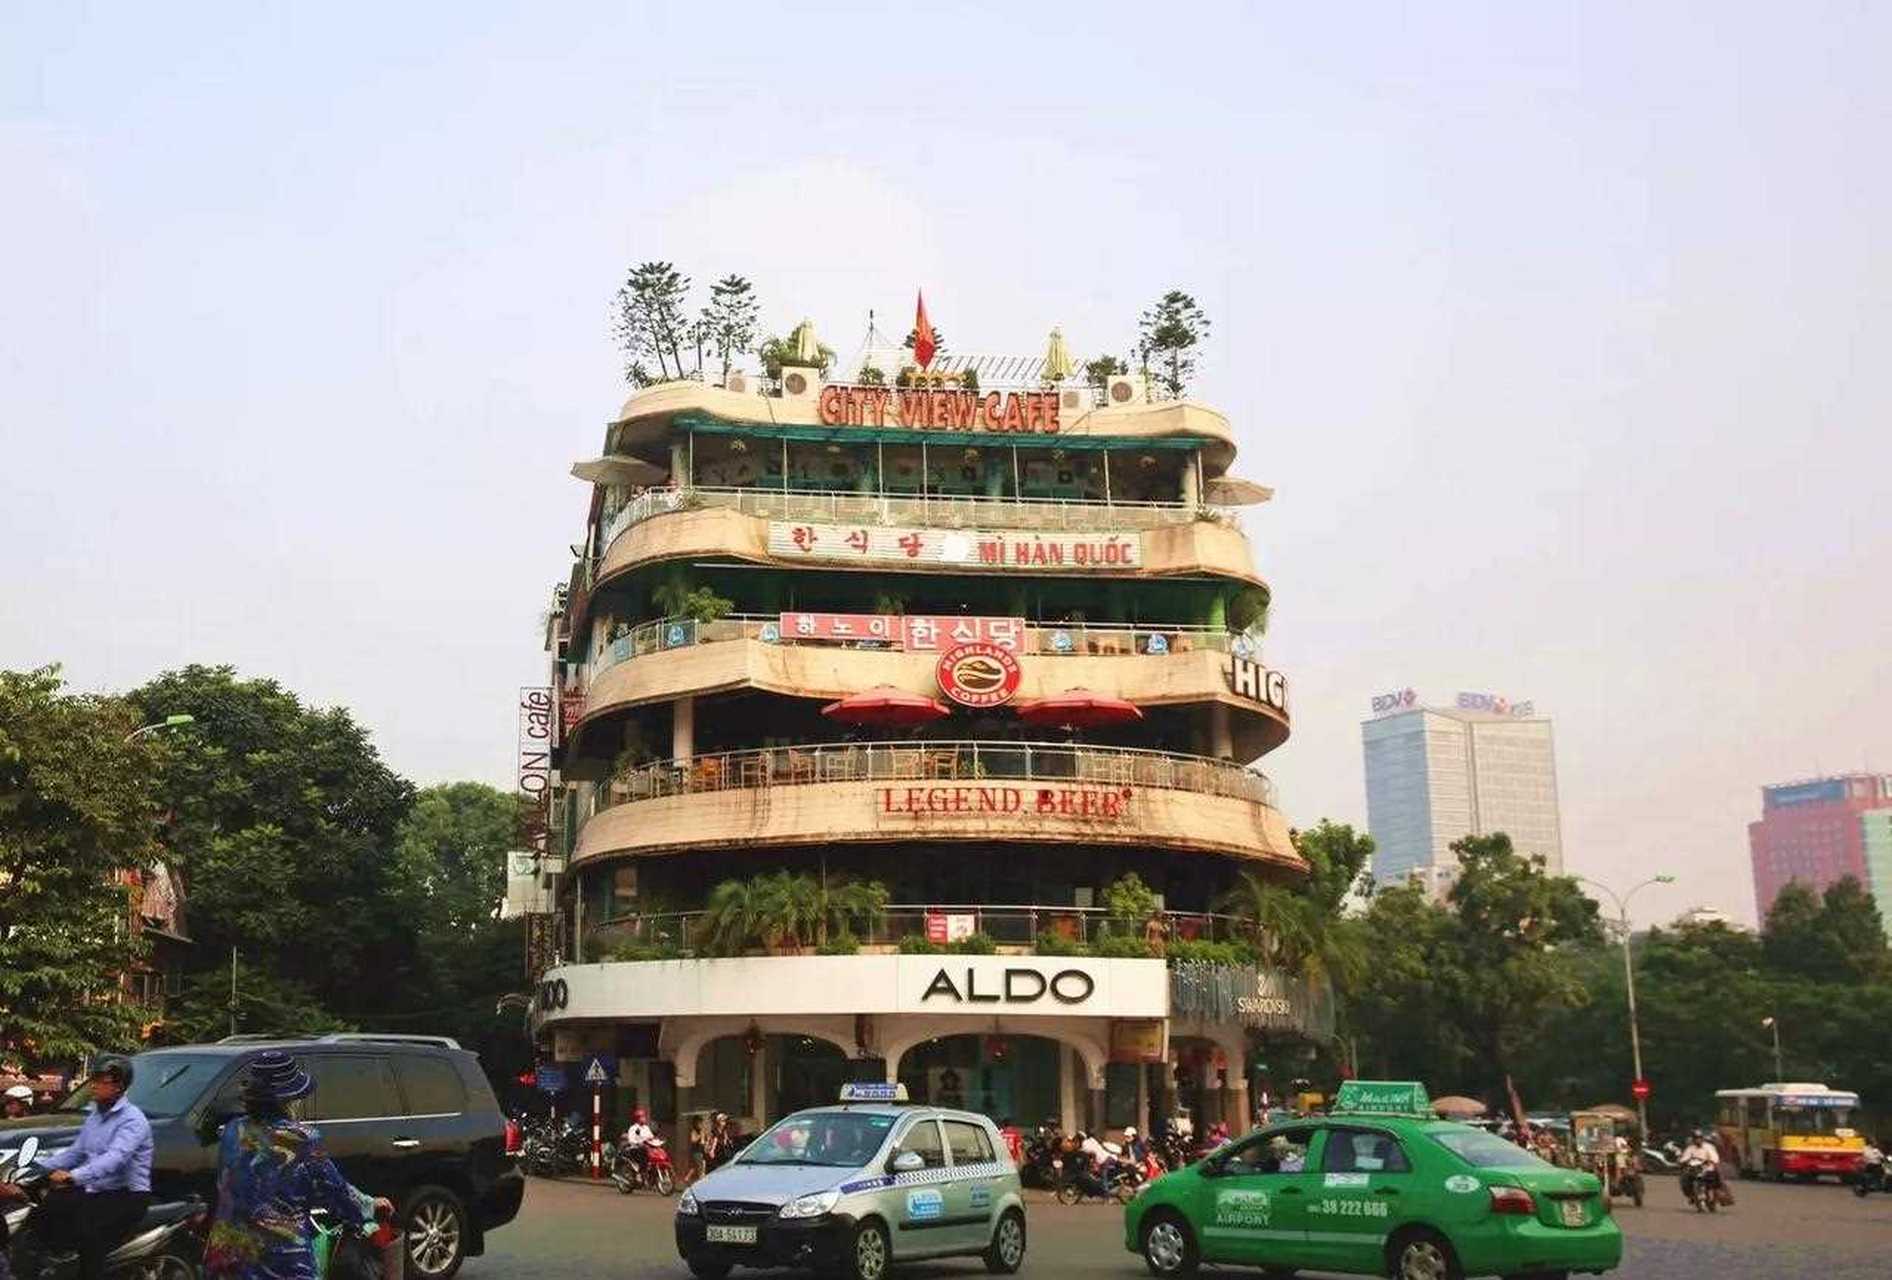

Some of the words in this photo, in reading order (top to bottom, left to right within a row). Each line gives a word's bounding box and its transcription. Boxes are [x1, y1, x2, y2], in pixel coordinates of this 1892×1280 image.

[820, 385, 889, 426] CITY
[899, 388, 980, 431] VIEW
[984, 390, 1061, 434] CAFE
[1014, 534, 1064, 565] HÀN
[1073, 534, 1134, 566] QUỐC
[908, 617, 1020, 650] 한식당
[941, 644, 1018, 673] HIGHLANDS
[949, 687, 1009, 705] COFFEE
[521, 691, 550, 739] cafe
[884, 787, 1022, 814] LEGEND
[1035, 788, 1121, 818] BEER
[921, 967, 1096, 1005] ALDO
[1215, 1213, 1270, 1225] AIRPORT
[1339, 1200, 1361, 1216] 222
